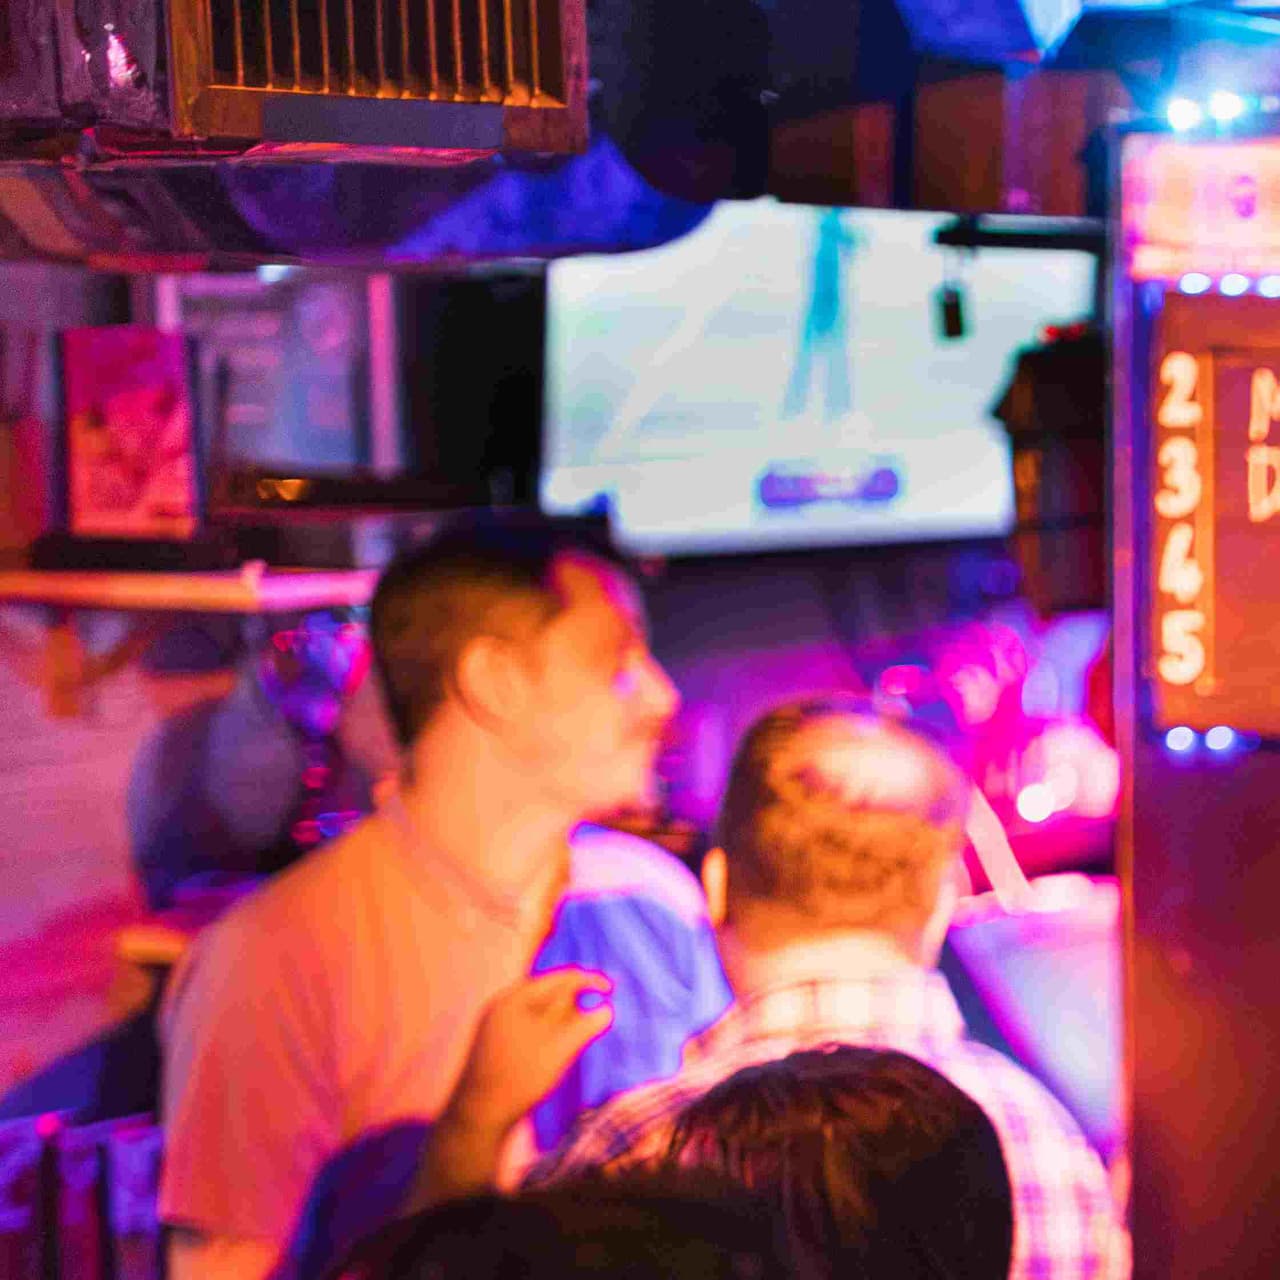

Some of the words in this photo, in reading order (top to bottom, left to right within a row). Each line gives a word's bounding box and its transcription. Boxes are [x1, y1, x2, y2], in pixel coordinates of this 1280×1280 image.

[1158, 351, 1202, 428] 2
[1155, 436, 1202, 518] 3
[1158, 524, 1203, 602] 4
[1158, 611, 1205, 685] 5
